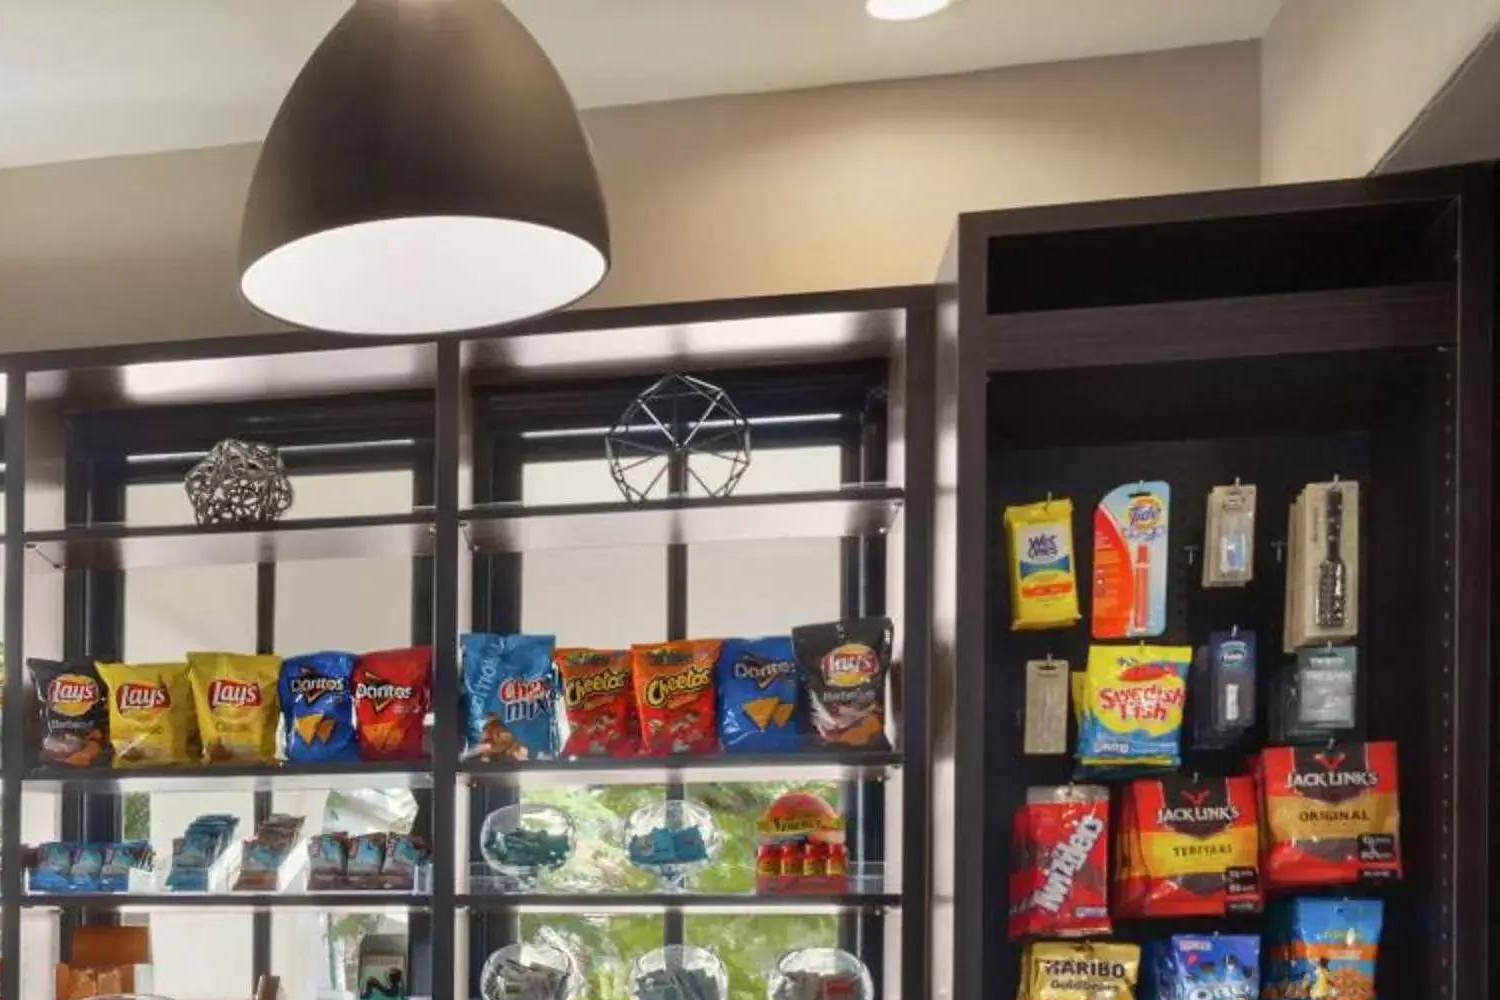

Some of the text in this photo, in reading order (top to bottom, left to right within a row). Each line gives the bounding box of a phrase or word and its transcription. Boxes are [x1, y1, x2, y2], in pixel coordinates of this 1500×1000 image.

[52, 679, 96, 703] Lay's
[212, 680, 258, 707] Lay's
[290, 676, 345, 693] Doritos
[356, 683, 413, 699] Doritos
[566, 668, 626, 705] Cheetos
[646, 666, 711, 706] Cheetos
[119, 684, 167, 709] Lay's
[1099, 684, 1186, 708] Swedish
[1118, 703, 1167, 721] Fish
[1283, 770, 1379, 789] JACK LINK'S
[1157, 805, 1240, 824] JACK LINK'S
[1299, 809, 1370, 822] ORIGINAL
[1172, 843, 1232, 857] TERIYAKI
[1045, 959, 1126, 978] HARIBO
